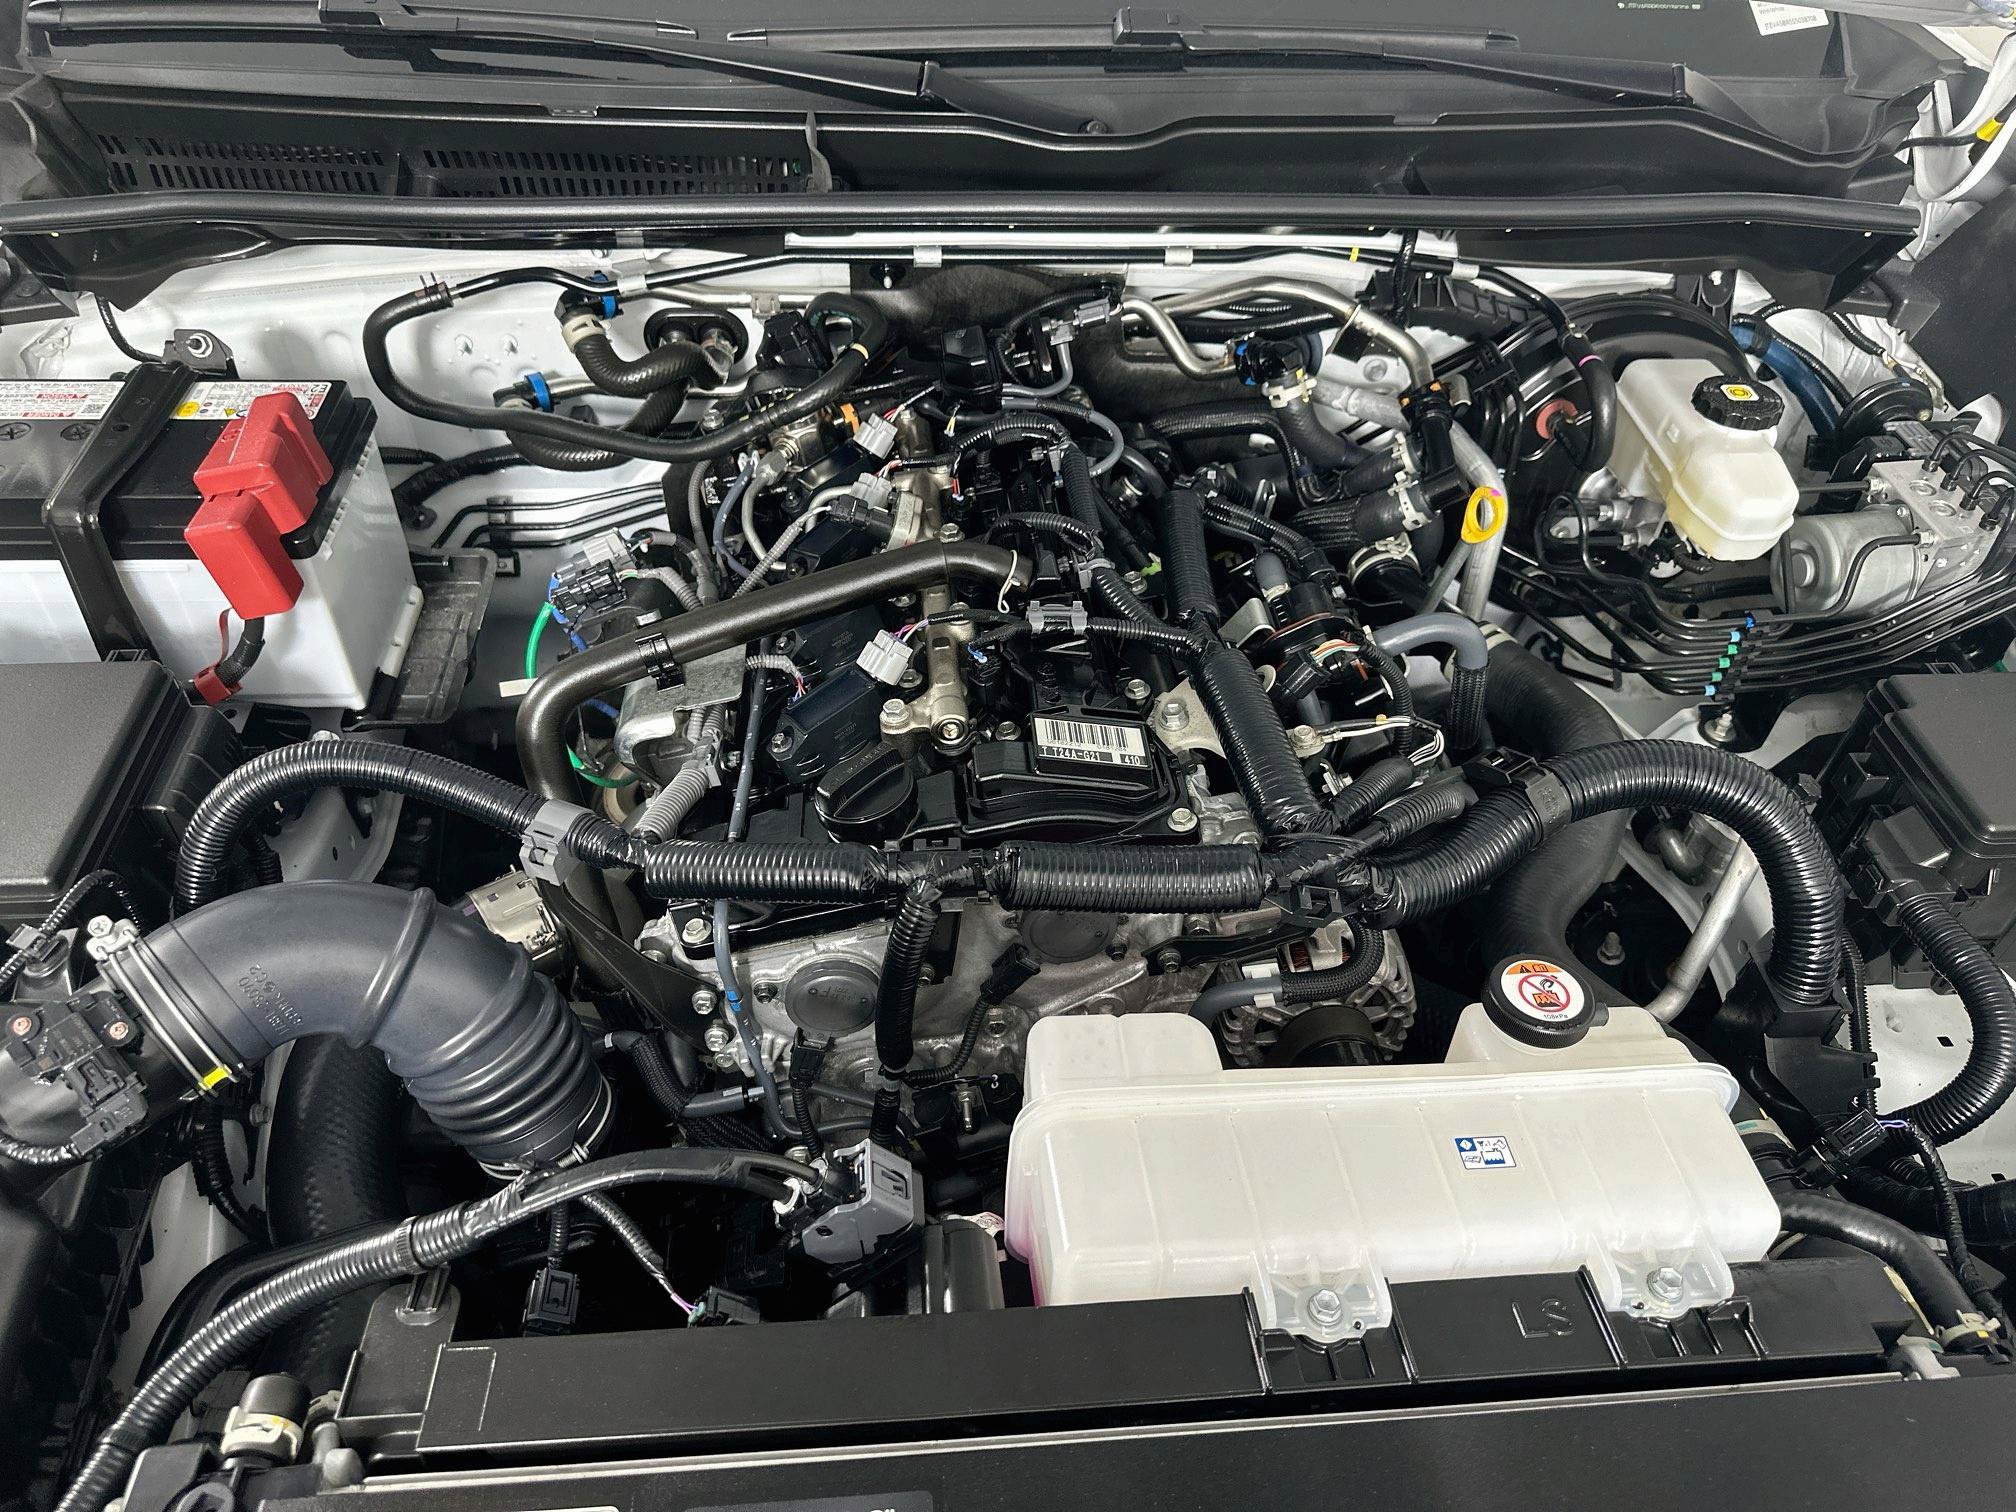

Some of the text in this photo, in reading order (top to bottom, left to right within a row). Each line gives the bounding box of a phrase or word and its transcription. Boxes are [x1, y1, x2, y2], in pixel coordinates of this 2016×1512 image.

[310, 384, 329, 393] E2
[1042, 746, 1141, 766] T T24A-G21 410
[1510, 1296, 1577, 1340] LS
